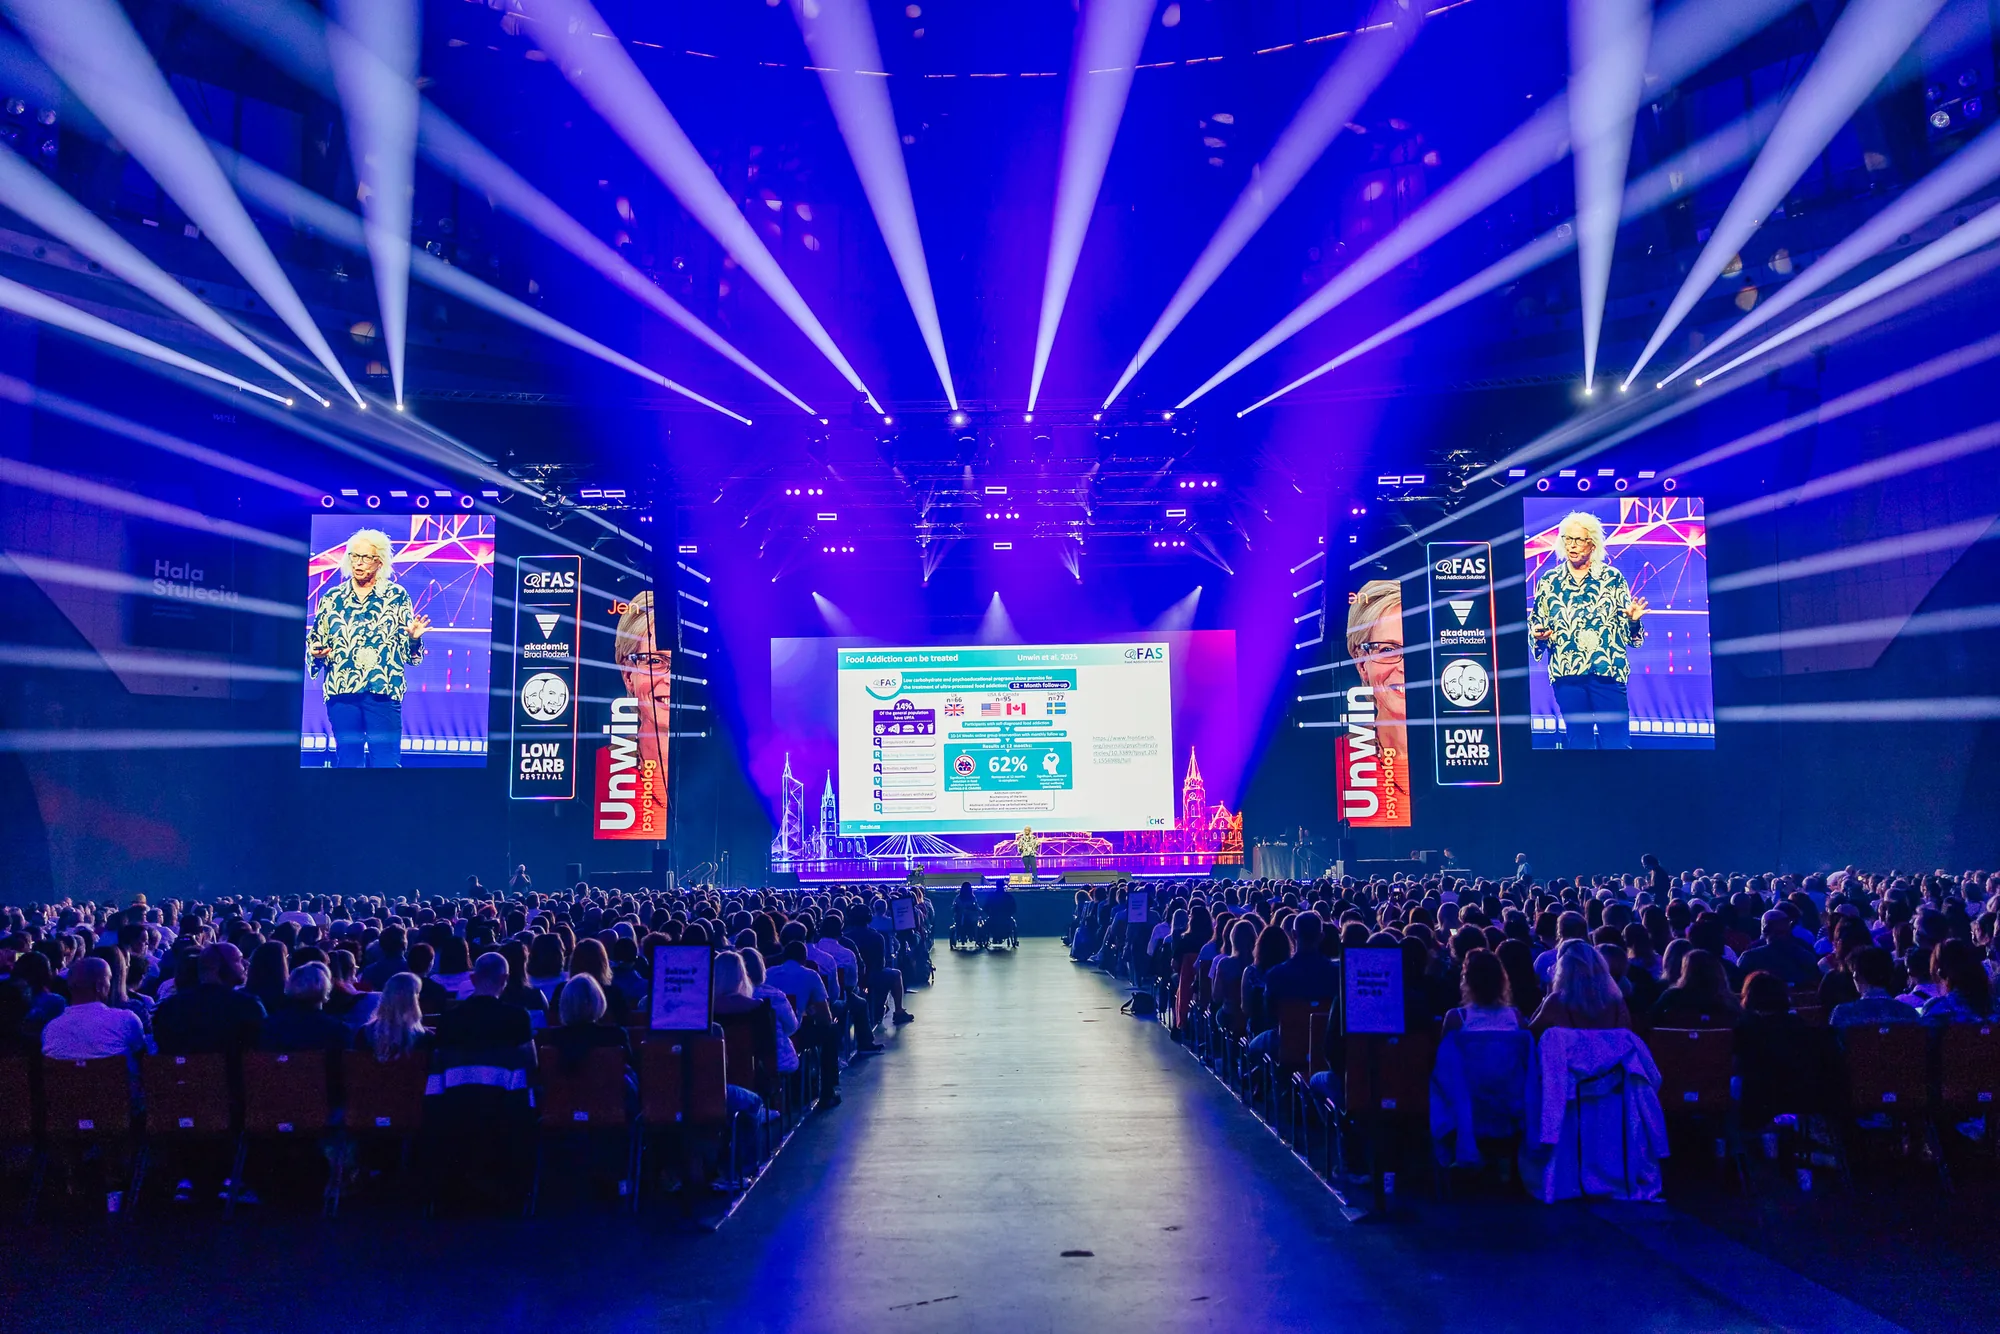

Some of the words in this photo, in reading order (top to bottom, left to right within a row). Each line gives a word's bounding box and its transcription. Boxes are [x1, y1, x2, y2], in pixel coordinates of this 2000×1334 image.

[154, 560, 204, 580] Hala
[1452, 558, 1486, 574] FAS
[541, 572, 574, 587] FAS
[1348, 592, 1368, 604] en
[608, 600, 640, 614] Jen
[1440, 628, 1484, 636] akademia
[1137, 648, 1163, 659] FAS
[1445, 729, 1483, 743] LOW
[522, 743, 560, 757] LOW
[1340, 686, 1378, 818] Unwin
[1446, 744, 1490, 758] CARB
[521, 758, 564, 772] CARB
[600, 697, 638, 830] Unwin
[988, 756, 1028, 773] 62%
[1382, 747, 1398, 819] psycholog
[641, 760, 657, 832] psycholog
